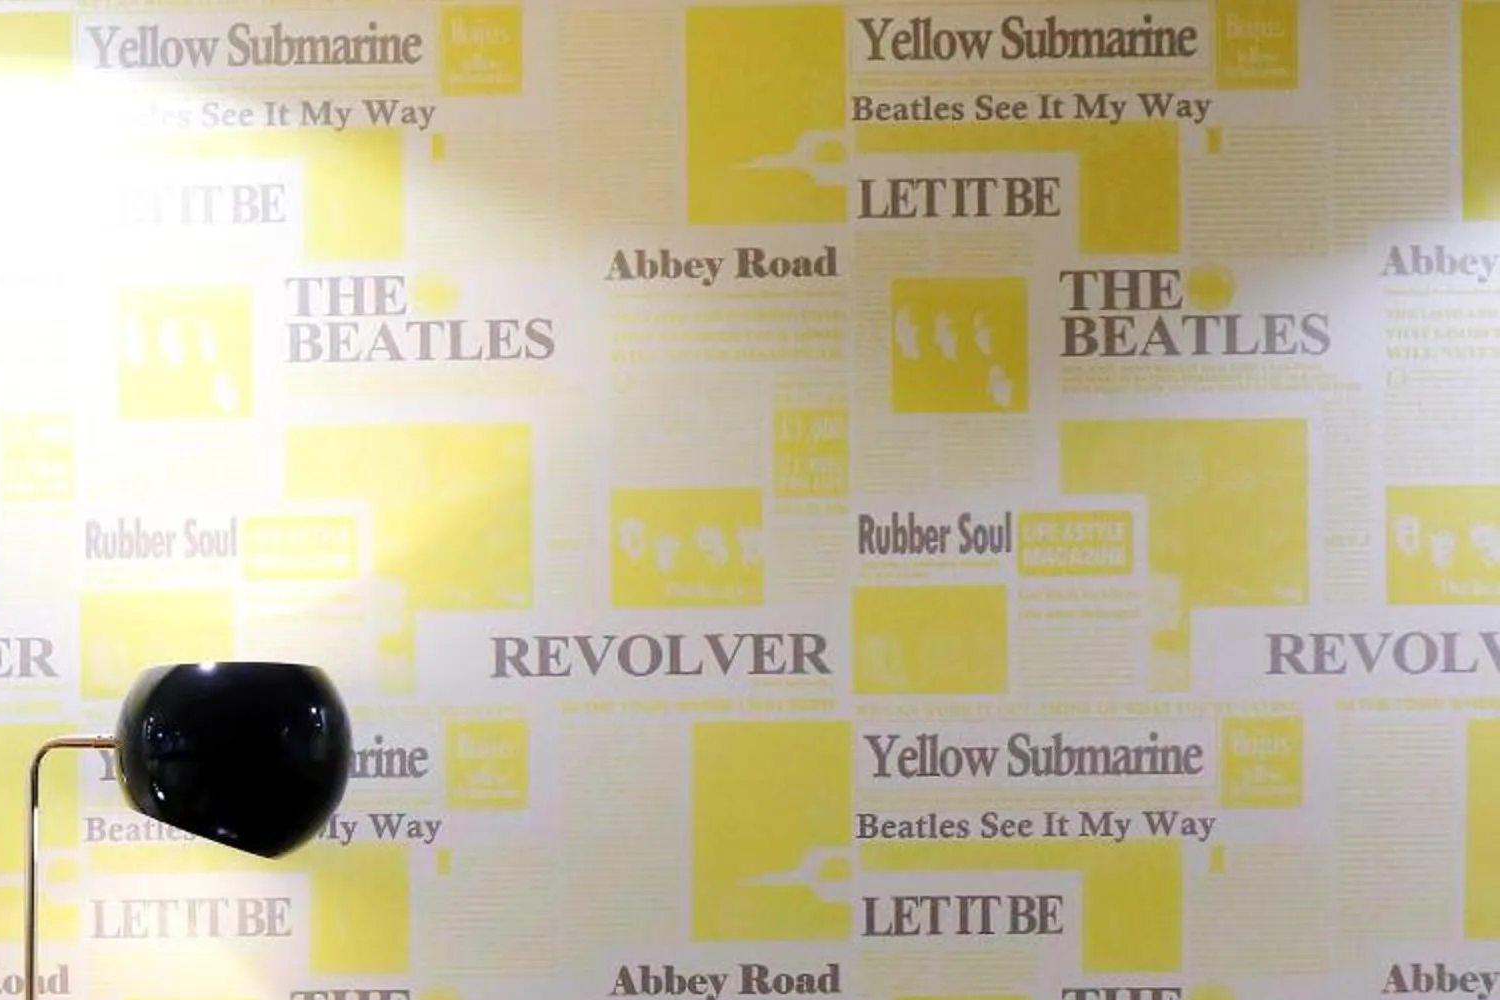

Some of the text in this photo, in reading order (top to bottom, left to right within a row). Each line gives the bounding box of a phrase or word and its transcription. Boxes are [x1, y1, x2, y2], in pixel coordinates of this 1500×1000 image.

[84, 24, 221, 69] Yellow
[227, 21, 422, 67] Submarine
[857, 17, 994, 61] Yellow
[1001, 14, 1197, 60] Submarine
[202, 102, 254, 127] See
[264, 101, 290, 126] It
[300, 100, 353, 132] My
[362, 99, 436, 131] Way
[852, 92, 1212, 125] Beatles See It My Way
[232, 183, 287, 224] BE
[858, 177, 1060, 219] LET IT BE
[605, 246, 839, 287] Abbey Road
[1380, 245, 1498, 284] Abbey
[285, 275, 407, 317] THE
[1059, 269, 1183, 311] THE
[289, 318, 555, 363] BEATLES
[1060, 314, 1330, 357] BEATLES
[85, 515, 237, 560] Rubber Soul
[858, 511, 1012, 555] Rubber Soul
[490, 633, 833, 678] REVOLVER
[863, 733, 1000, 779] Yellow
[1007, 732, 1203, 777] Submarine
[367, 813, 442, 844] Way
[856, 810, 1216, 843] Beatles See It My Way
[89, 899, 179, 939] LET
[237, 897, 292, 937] BE
[861, 895, 1063, 937] LET IT BE
[738, 963, 841, 995] Road
[1381, 963, 1500, 1000] Abbey
